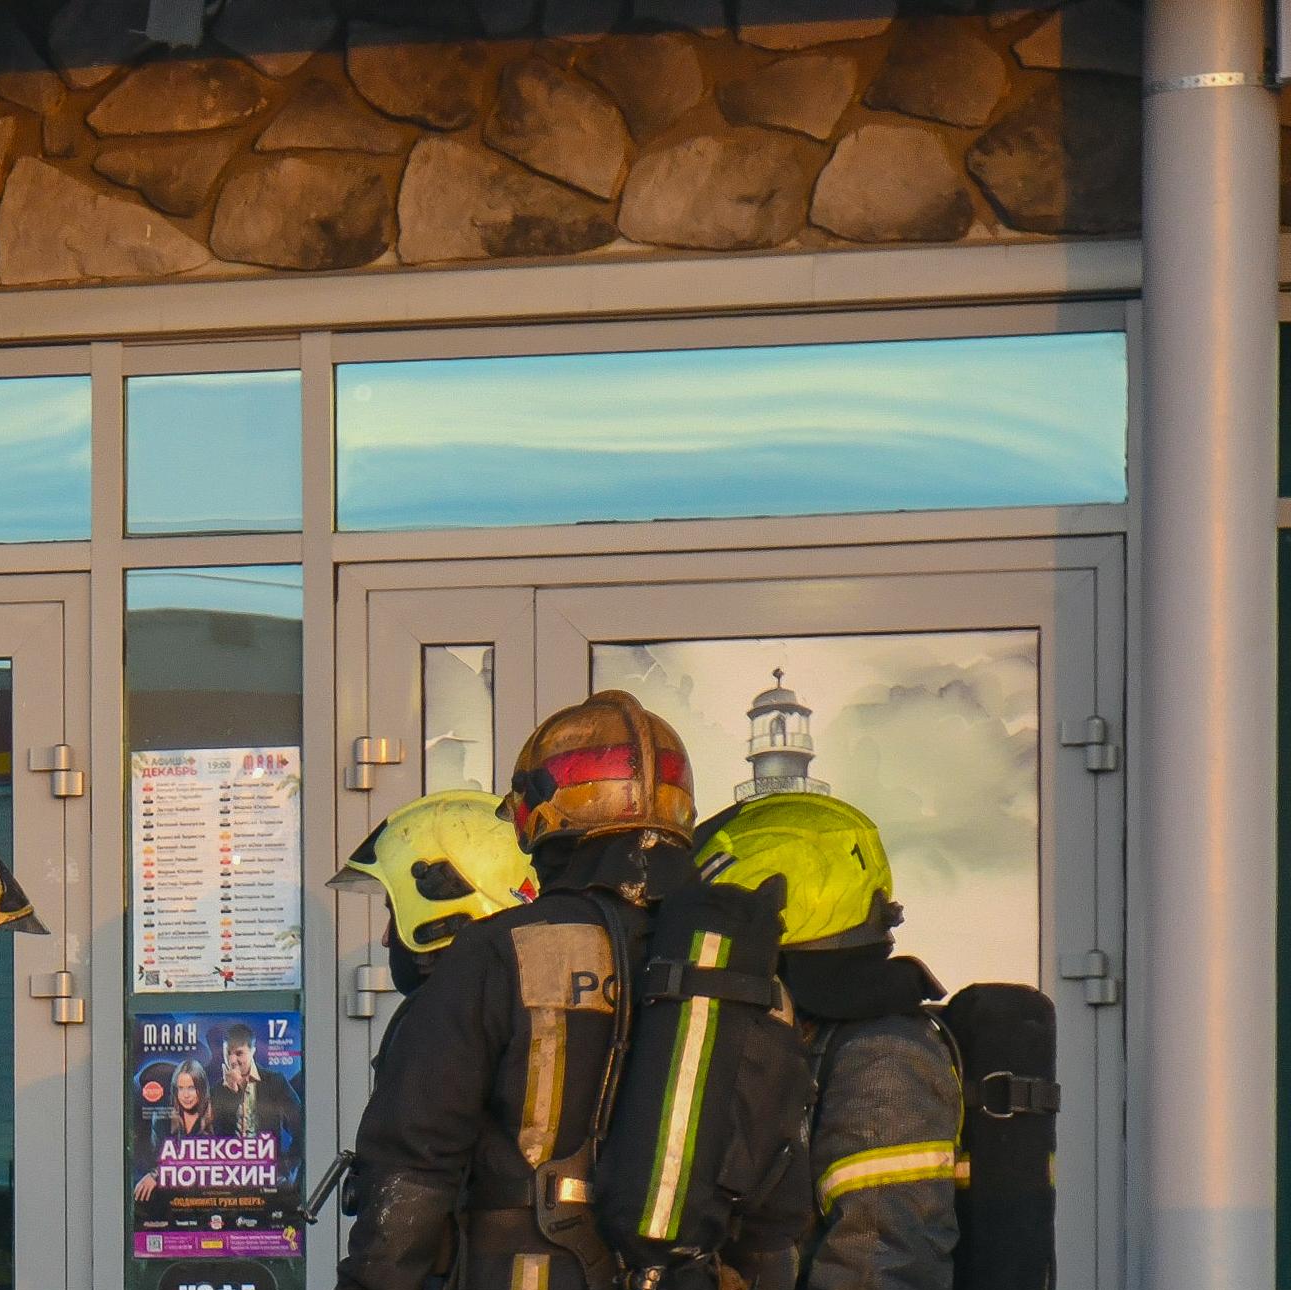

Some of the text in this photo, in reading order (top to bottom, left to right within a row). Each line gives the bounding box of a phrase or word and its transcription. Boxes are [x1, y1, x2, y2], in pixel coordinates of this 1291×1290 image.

[142, 766, 198, 778] ДЕКАБРЬ
[850, 842, 866, 871] 1
[268, 1019, 288, 1038] 17
[267, 1056, 294, 1066] 20:00
[160, 1133, 275, 1160] АЛЕКСЕЙ
[159, 1165, 276, 1186] ПОТЕХИН
